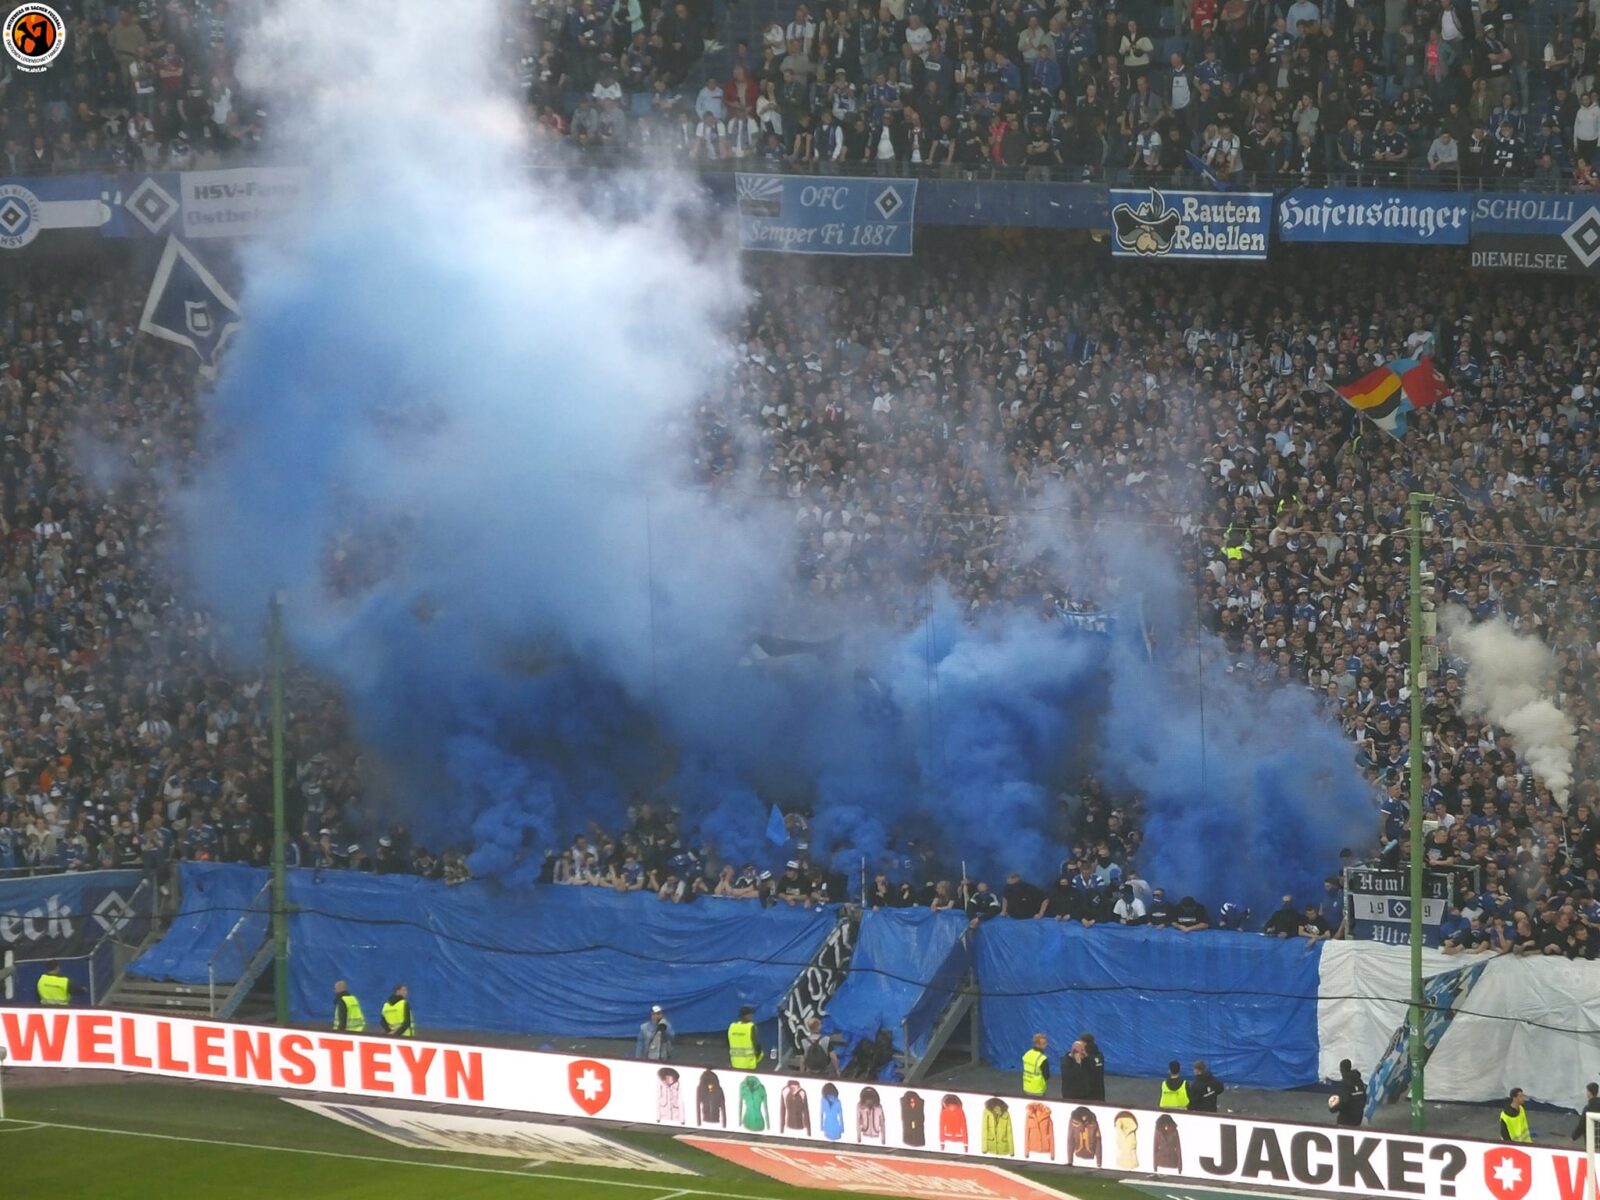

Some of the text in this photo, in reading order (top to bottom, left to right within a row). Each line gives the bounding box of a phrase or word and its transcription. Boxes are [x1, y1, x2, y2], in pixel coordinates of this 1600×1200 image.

[800, 185, 848, 210] OFC
[1182, 197, 1261, 223] Rauten
[1476, 199, 1575, 221] SCHOLLI
[1278, 197, 1468, 237] Hafensänger
[1, 236, 23, 247] HSV
[750, 220, 897, 249] Semper Fi 1887
[1174, 225, 1265, 251] Rebellen
[1472, 251, 1568, 270] DIEMELSEE
[1369, 901, 1385, 914] 19
[2, 1012, 485, 1102] WELLENSTEYN
[1199, 1123, 1468, 1197] JACKE?
